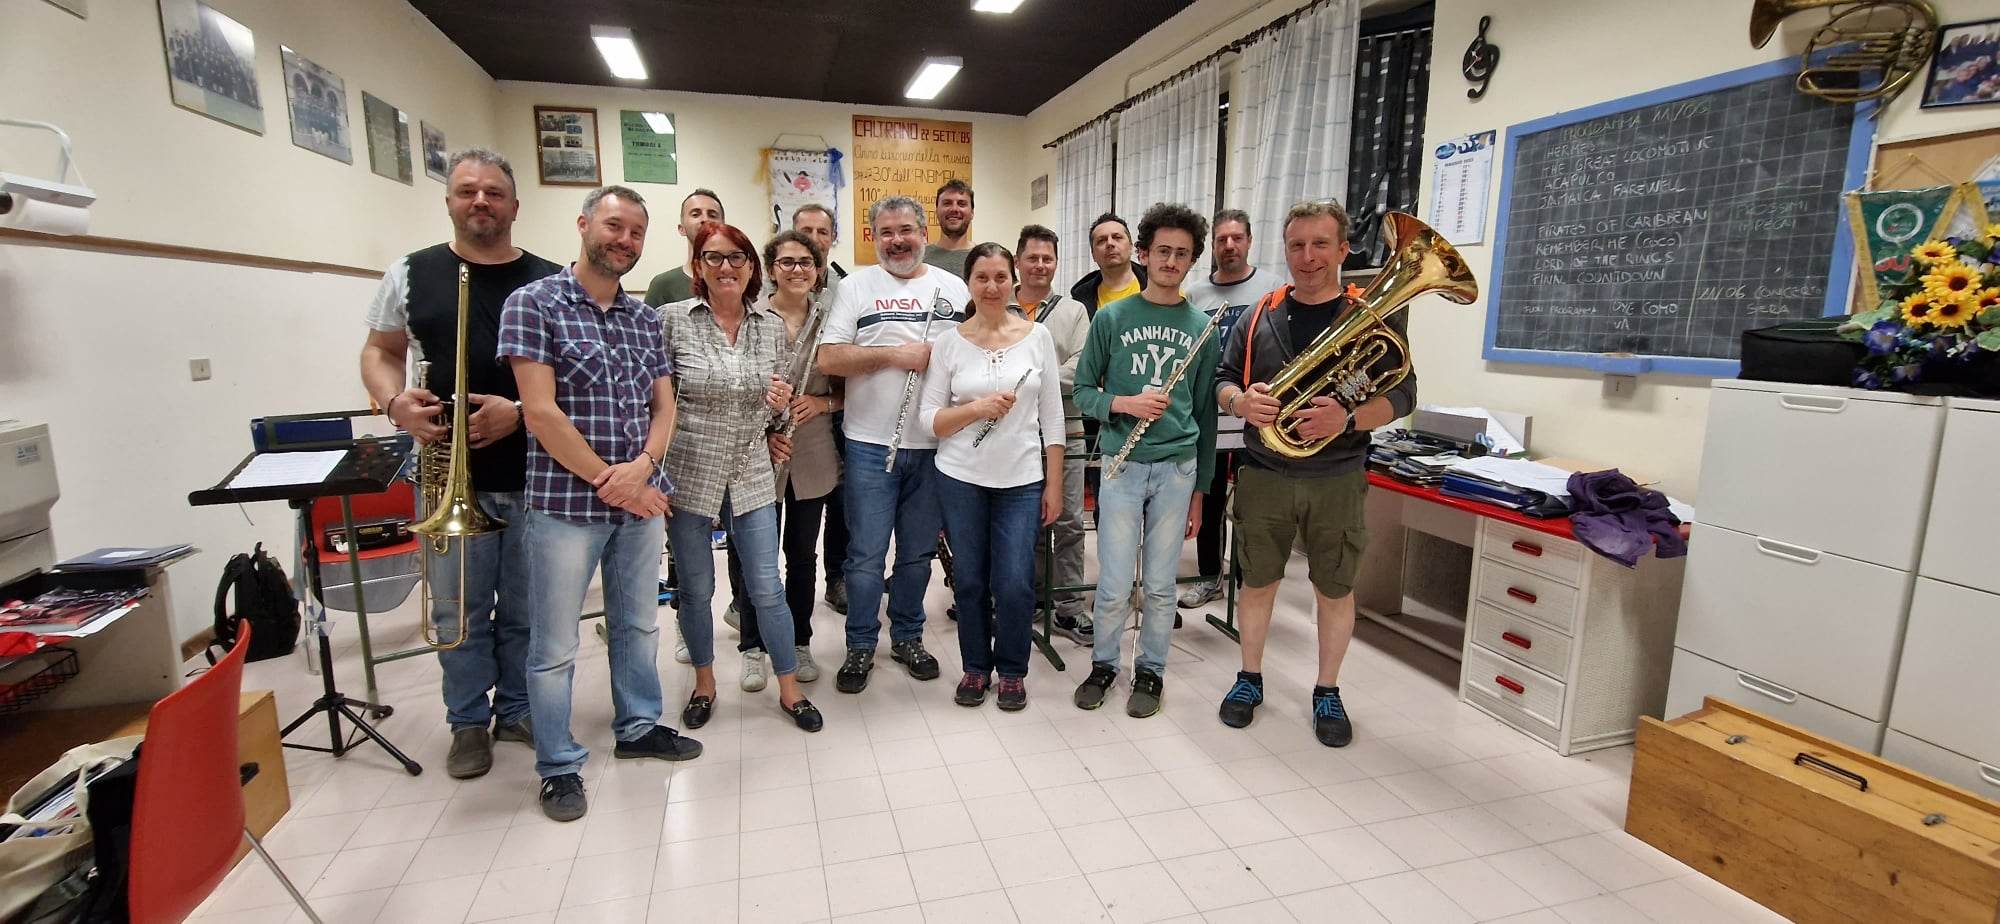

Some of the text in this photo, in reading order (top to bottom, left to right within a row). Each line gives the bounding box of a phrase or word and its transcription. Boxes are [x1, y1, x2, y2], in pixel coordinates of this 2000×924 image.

[855, 119, 918, 140] CALTRANO
[921, 128, 929, 141] 22
[1546, 142, 1596, 159] HERMES
[1543, 163, 1565, 178] THE
[1544, 171, 1616, 192] ACAPULCO
[860, 187, 881, 202] 110°
[1539, 179, 1687, 210] JAMAICA FAREWELL
[1538, 208, 1708, 239] PIRATES OF CARIBBEAN
[1535, 239, 1603, 257] REMEMBER
[1607, 236, 1629, 250] ME
[1535, 251, 1675, 271] LORD OF THE RINGS
[1532, 268, 1666, 286] FINAL COUNTDOWN
[876, 298, 923, 311] NASA
[1611, 300, 1635, 315] OYE
[1642, 301, 1679, 315] COMO
[1614, 318, 1631, 329] VA
[1119, 325, 1194, 351] MANHATTA
